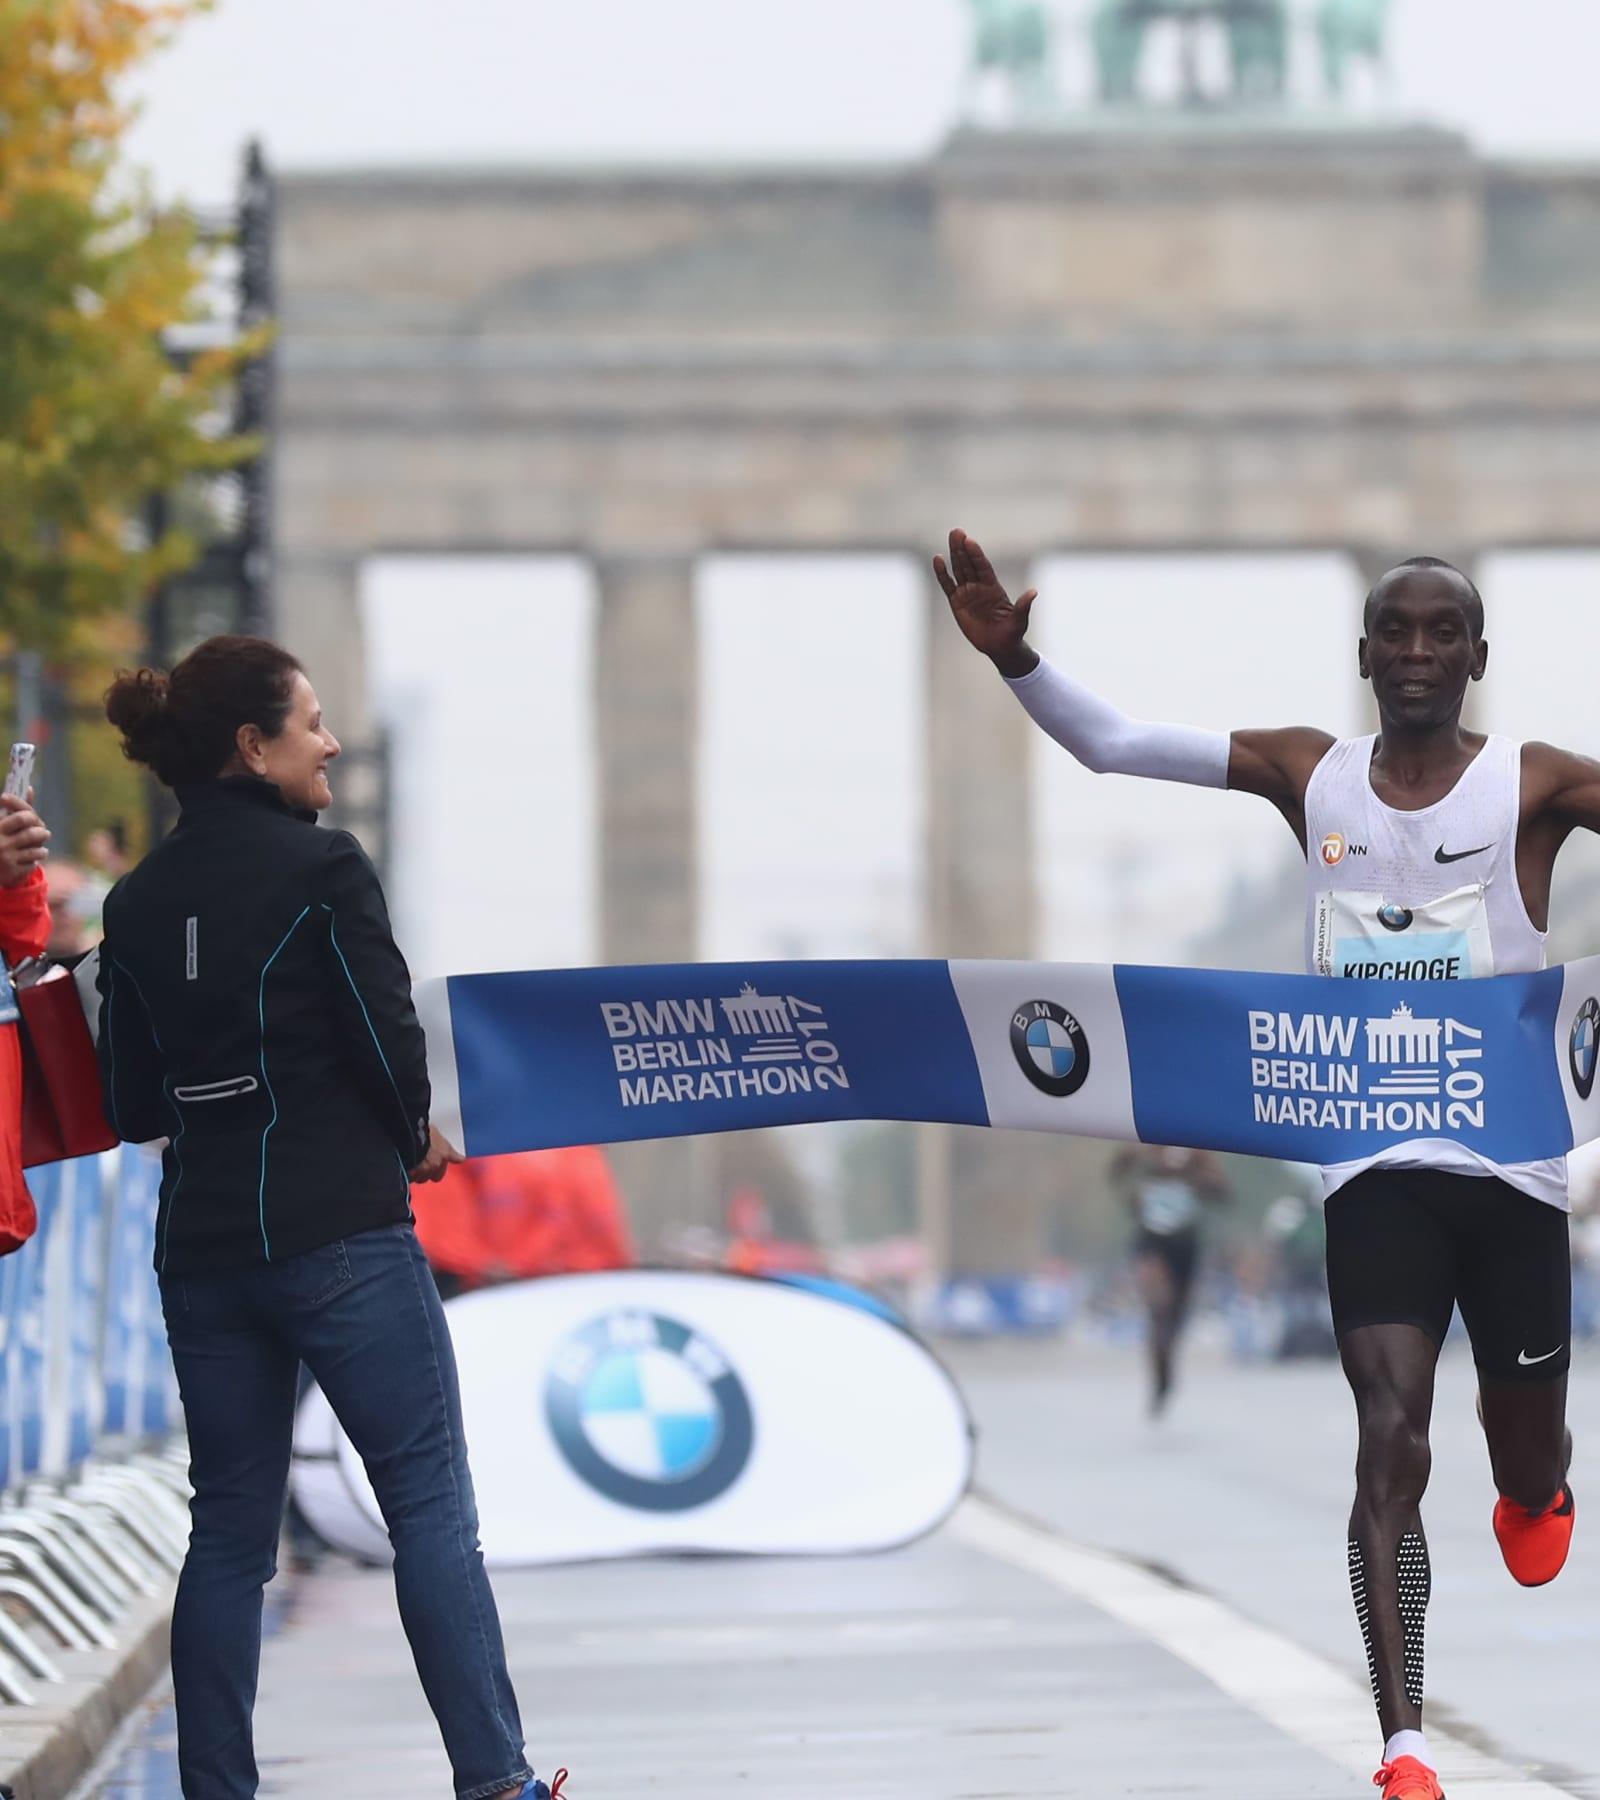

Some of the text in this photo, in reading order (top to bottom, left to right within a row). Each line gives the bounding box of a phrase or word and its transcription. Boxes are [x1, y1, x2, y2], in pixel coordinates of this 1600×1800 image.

[1348, 845, 1368, 856] NN
[1344, 957, 1461, 981] KIPCHOGE
[600, 998, 715, 1039] BMW
[1013, 1002, 1080, 1035] BMW
[1248, 1010, 1358, 1057] BMW
[612, 1038, 733, 1073] BERLIN
[785, 995, 851, 1091] 2017
[618, 1066, 813, 1107] MARATHON
[1251, 1057, 1359, 1094] BERLIN
[1445, 1018, 1485, 1129] 2017
[1253, 1093, 1442, 1132] MARATHON
